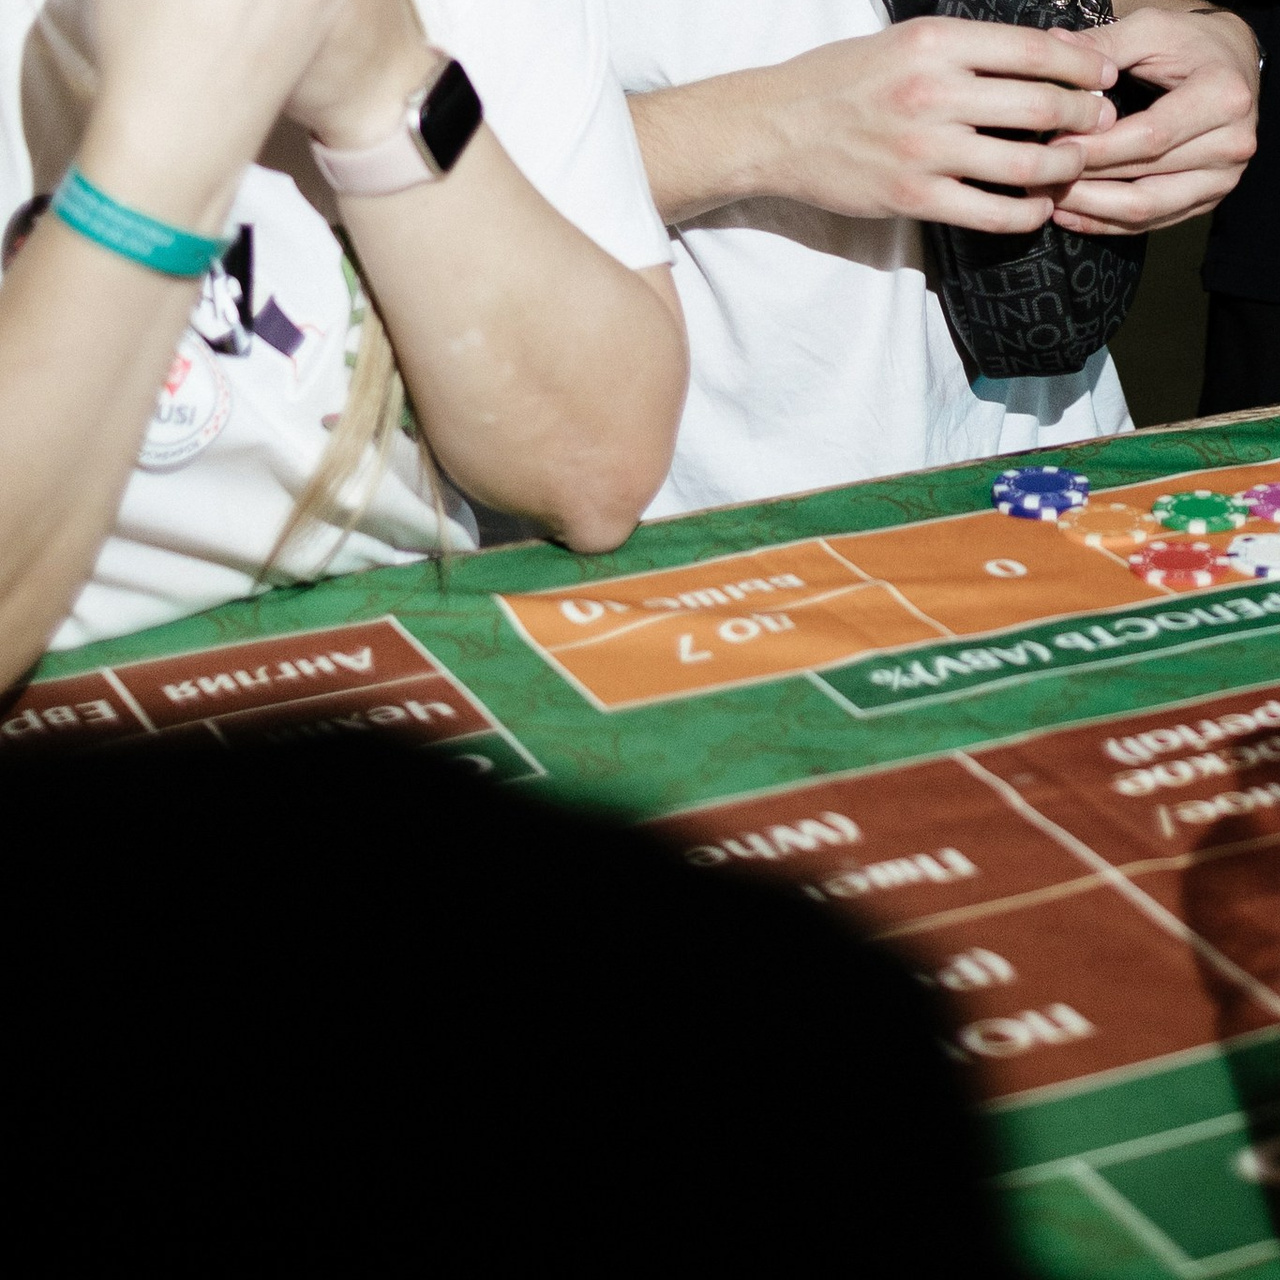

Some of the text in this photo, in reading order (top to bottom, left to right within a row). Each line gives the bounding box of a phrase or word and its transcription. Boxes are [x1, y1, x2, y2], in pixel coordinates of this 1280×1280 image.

[678, 612, 796, 664] до 7
[161, 646, 376, 704] Англия
